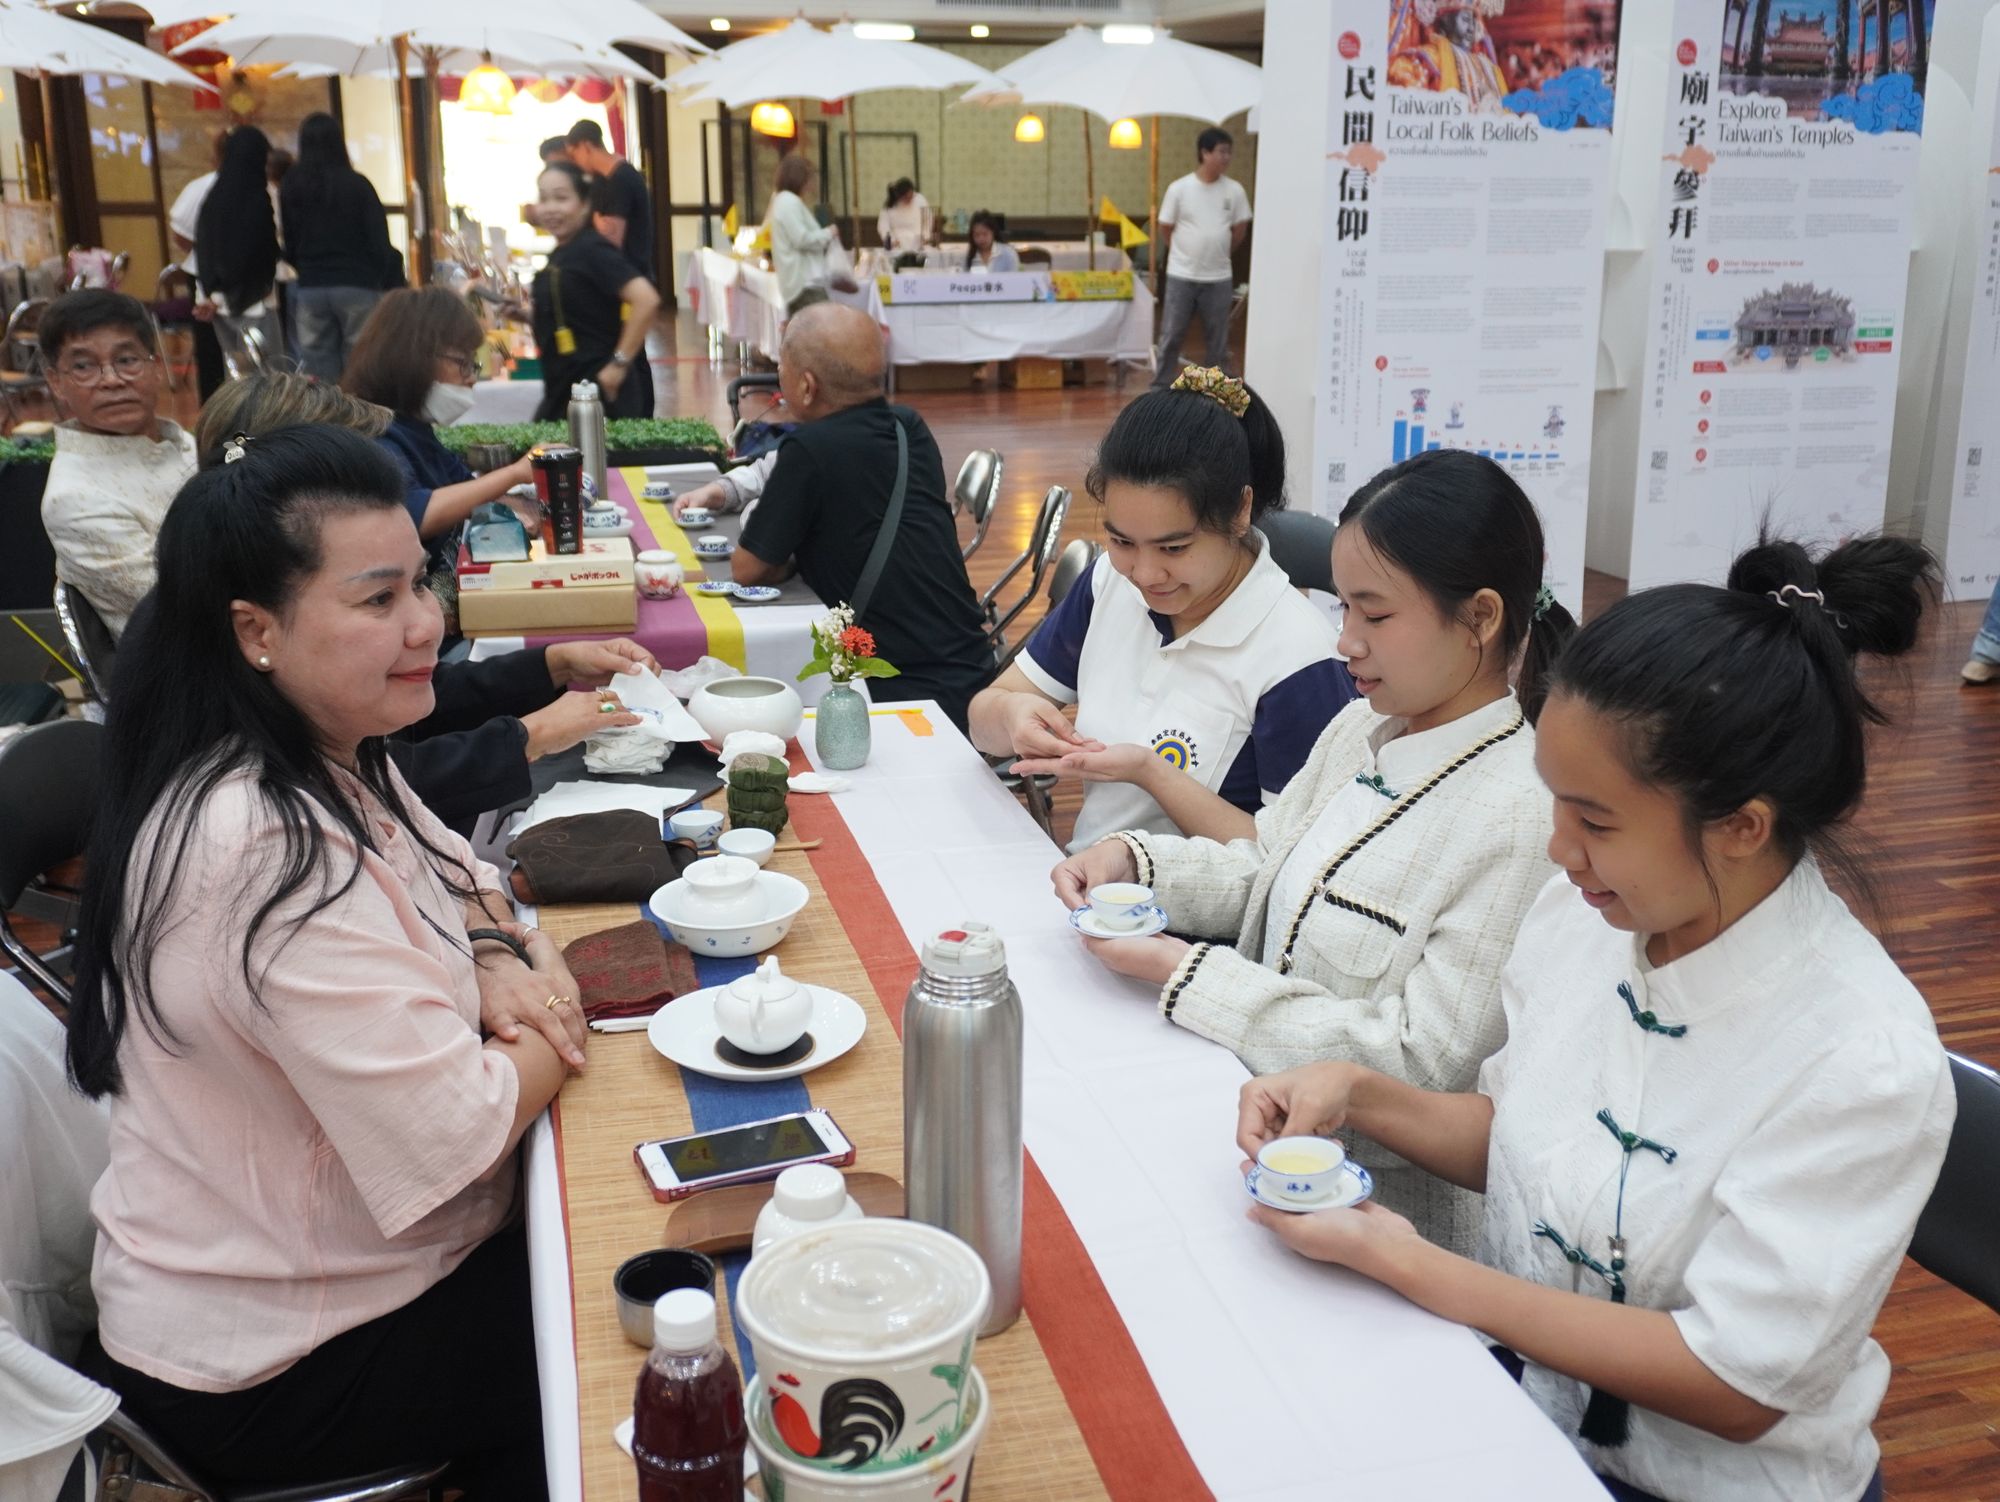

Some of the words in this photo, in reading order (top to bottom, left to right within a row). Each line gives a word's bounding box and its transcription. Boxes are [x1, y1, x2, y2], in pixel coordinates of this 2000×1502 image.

[1389, 94, 1462, 116] Taiwan's
[1718, 99, 1781, 123] Explore
[1386, 120, 1433, 140] Local
[1441, 121, 1475, 141] Folk
[1482, 121, 1539, 142] Beliefs
[1718, 123, 1783, 143] Taiwan's
[1790, 125, 1855, 148] Temples
[1337, 64, 1375, 241] 民間信仰
